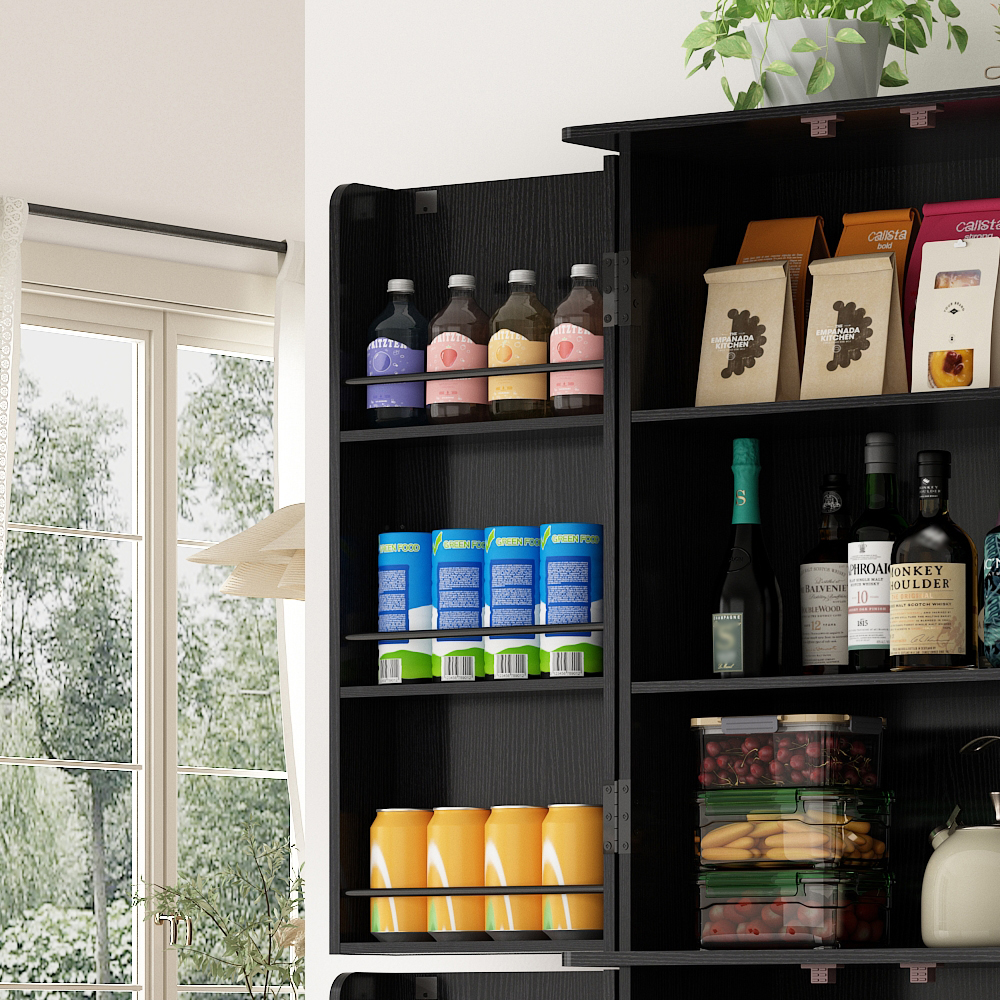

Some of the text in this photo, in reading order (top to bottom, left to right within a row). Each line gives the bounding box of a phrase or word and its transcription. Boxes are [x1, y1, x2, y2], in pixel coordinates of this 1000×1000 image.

[816, 327, 860, 336] EMPANADA
[711, 335, 755, 344] EMPANADA
[821, 333, 855, 341] KITCHEN
[715, 341, 749, 349] KITCHEN
[735, 489, 747, 506] S
[496, 537, 540, 546] GREEN FOO
[552, 534, 600, 544] GREEN FOOD
[397, 543, 420, 552] FOOD
[443, 540, 485, 549] GREEN FO
[805, 584, 847, 593] BALVENIE
[890, 578, 950, 591] HOULDER
[857, 590, 868, 604] 10
[811, 620, 822, 630] 12
